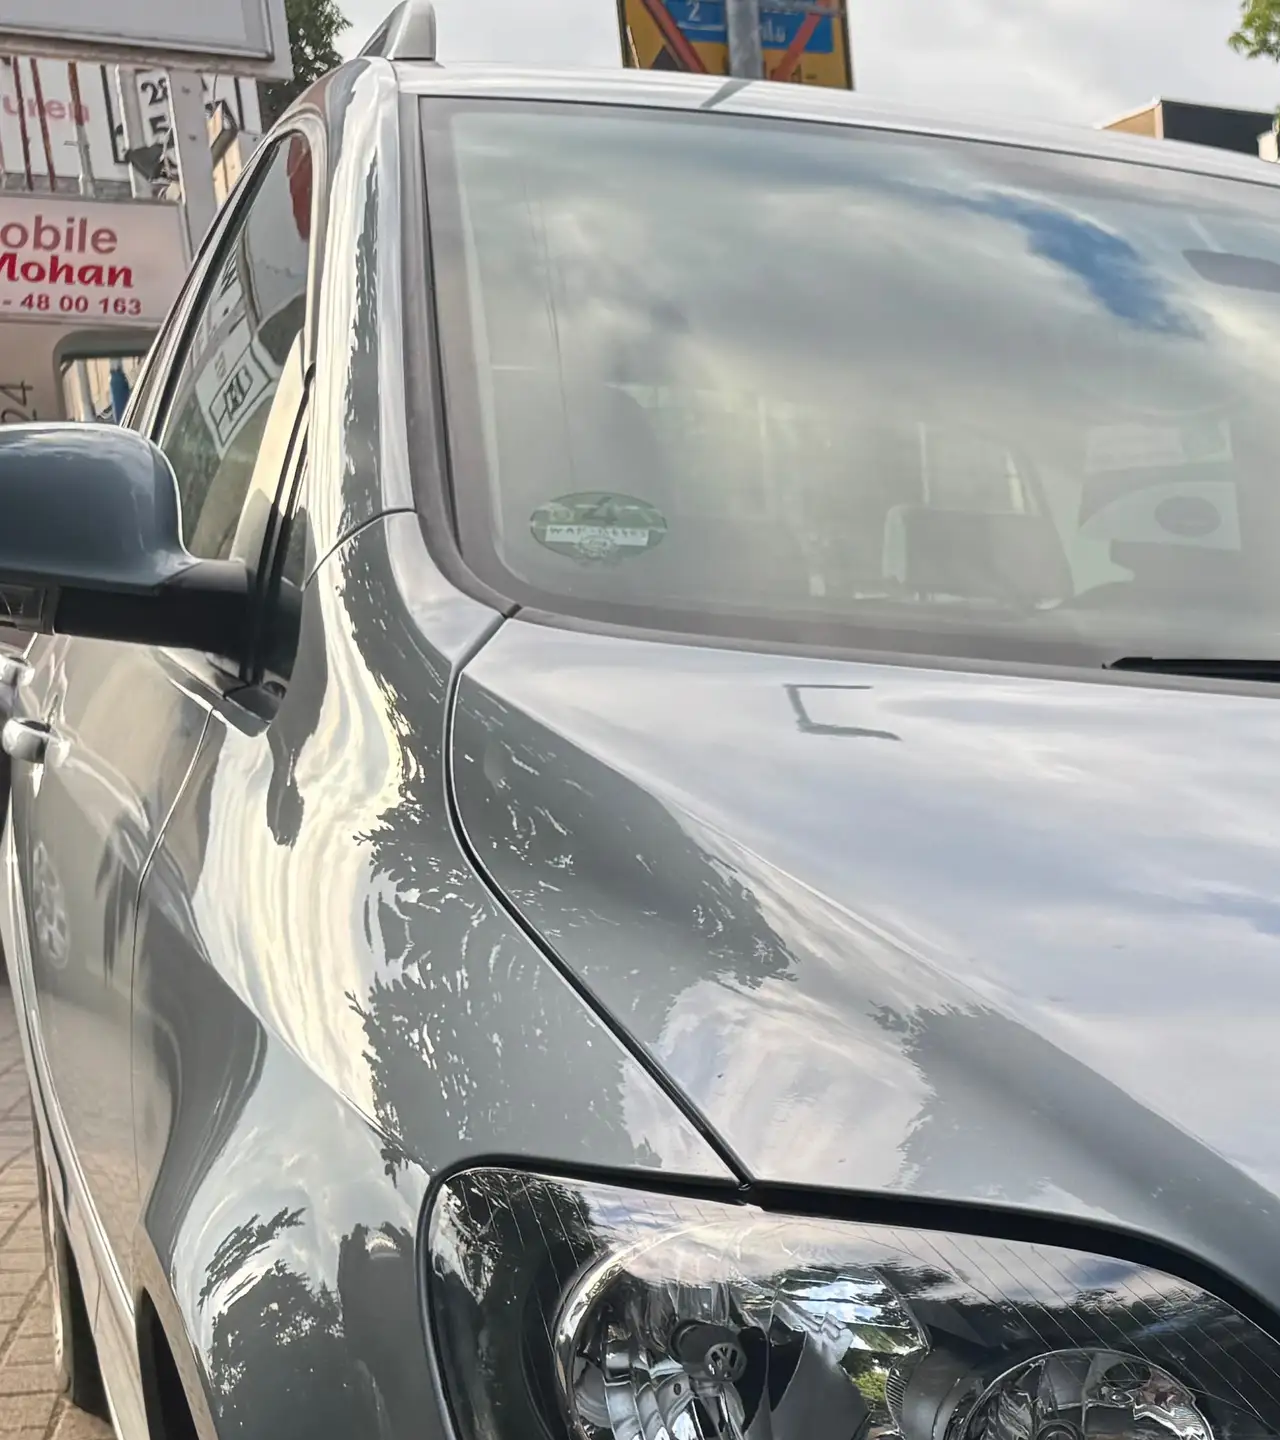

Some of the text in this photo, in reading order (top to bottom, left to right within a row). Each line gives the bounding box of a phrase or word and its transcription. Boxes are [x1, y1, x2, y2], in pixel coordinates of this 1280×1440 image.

[0, 214, 118, 255] obile
[20, 292, 51, 312] 48
[59, 294, 89, 314] 00
[98, 296, 143, 316] 163
